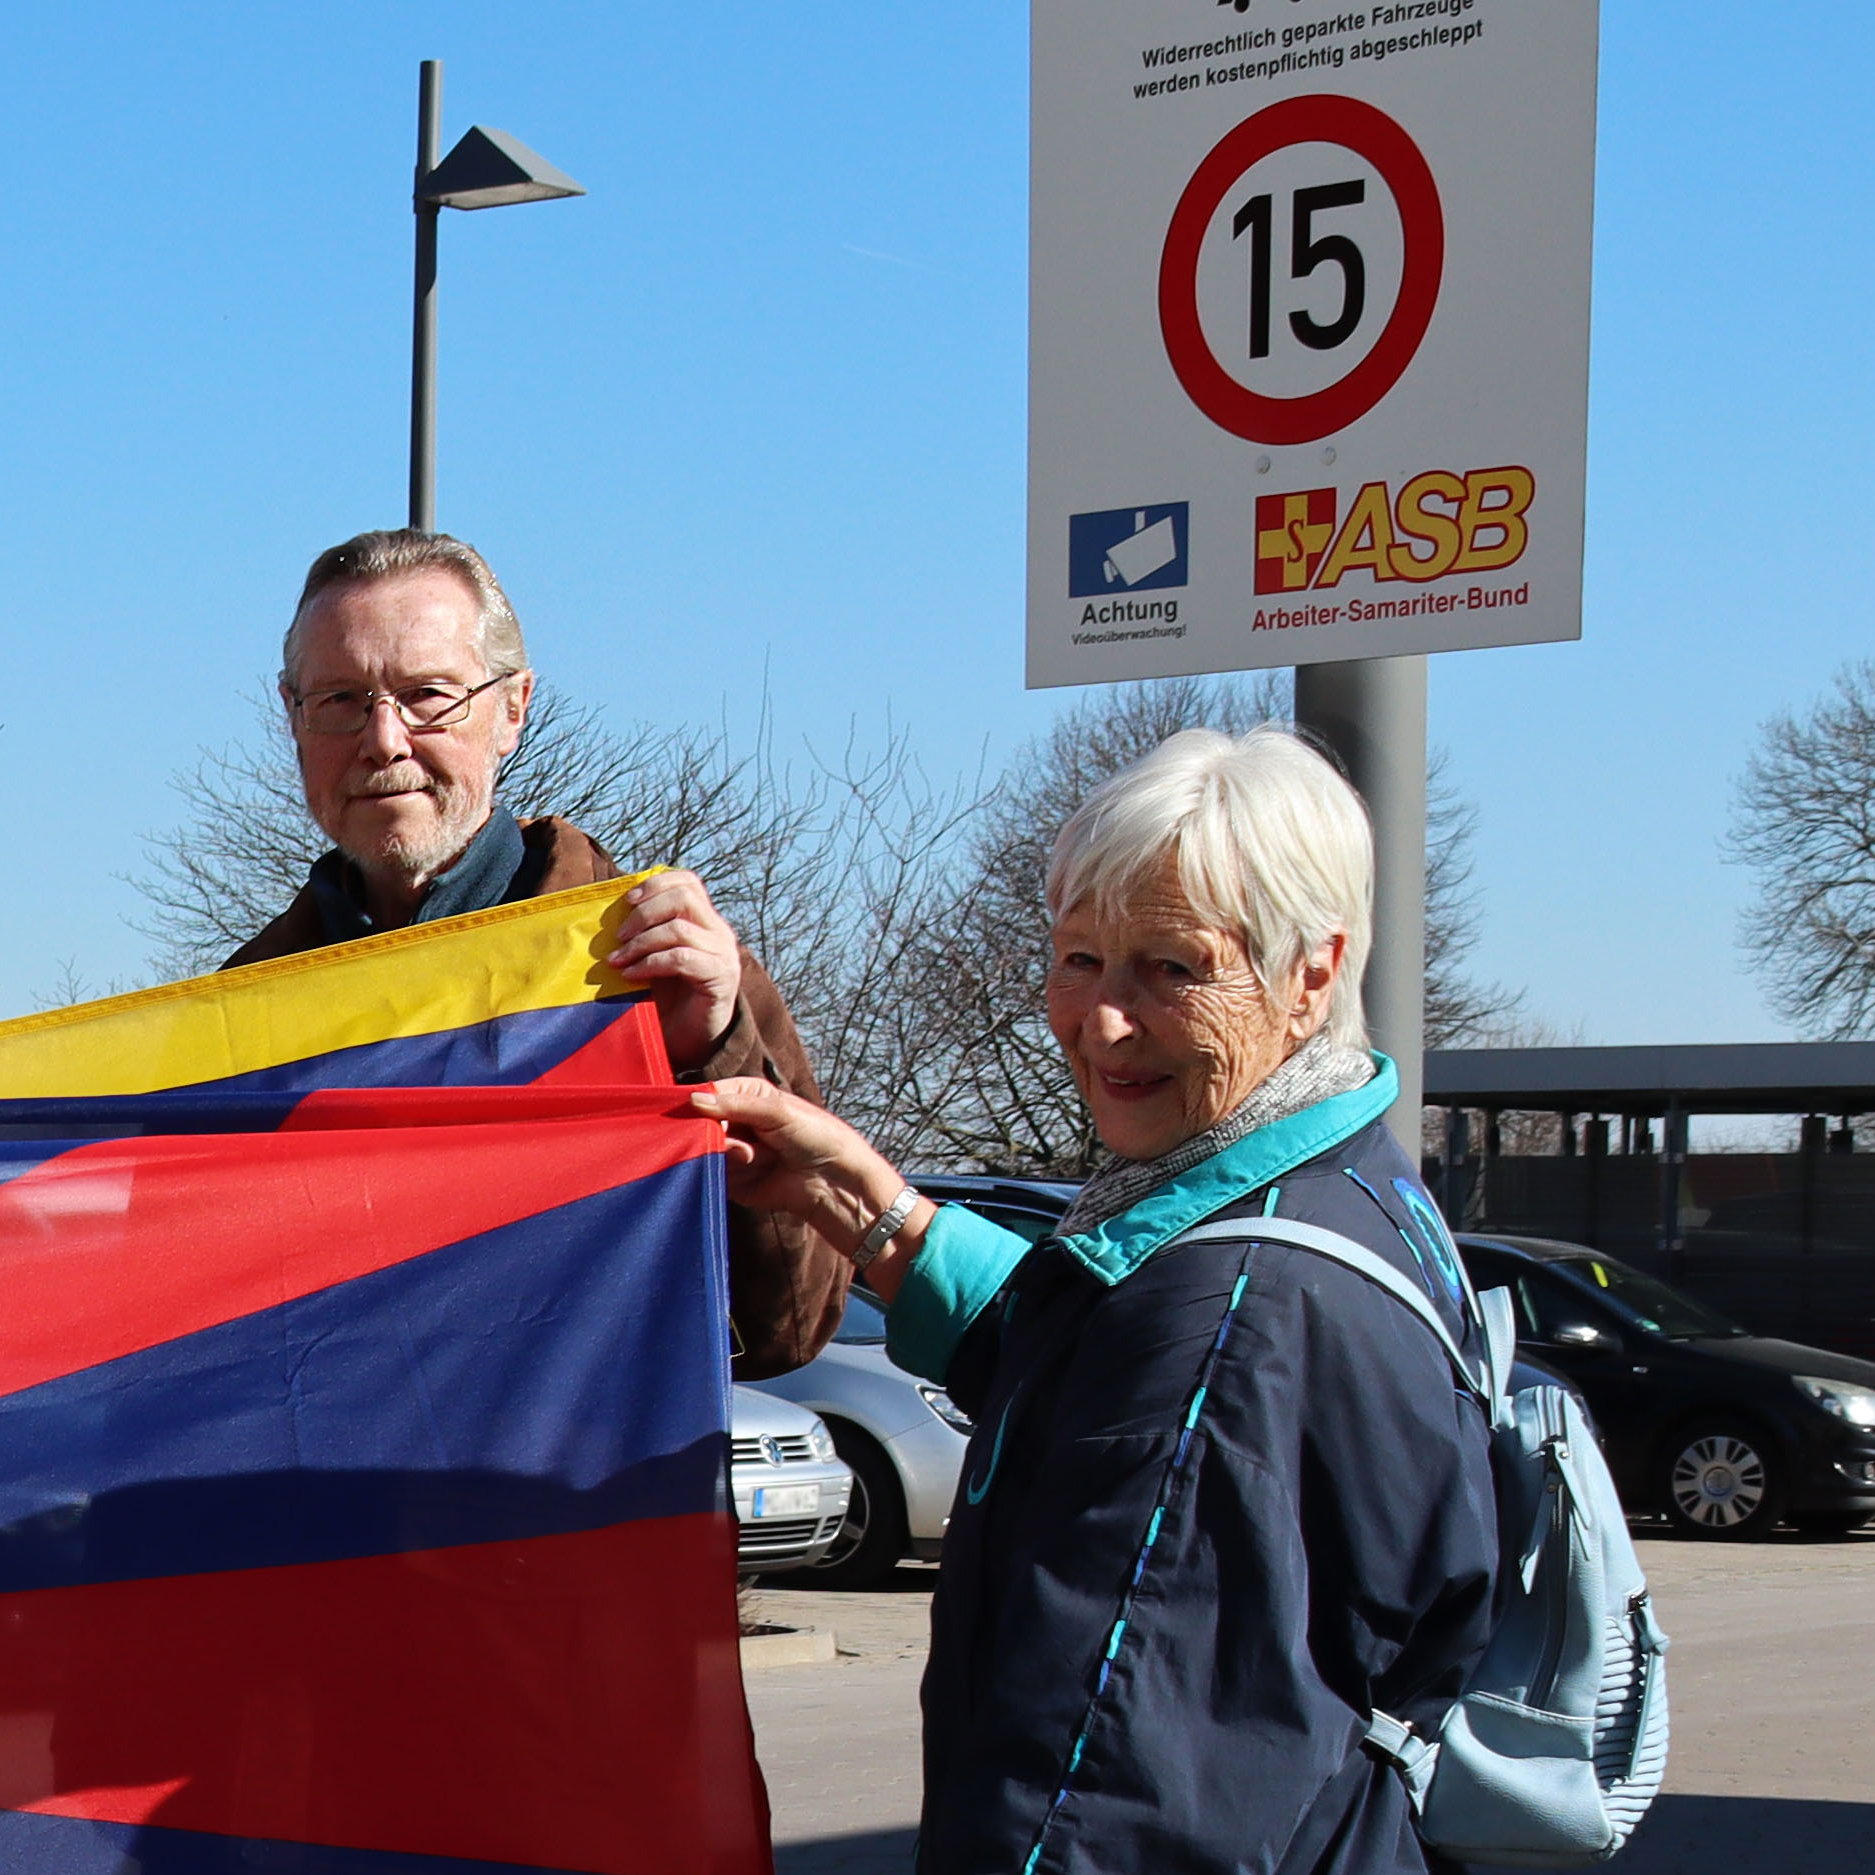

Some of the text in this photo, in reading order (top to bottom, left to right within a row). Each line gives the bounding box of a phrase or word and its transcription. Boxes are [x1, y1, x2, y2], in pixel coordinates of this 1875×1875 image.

[1133, 20, 1484, 99] werden kostenpflichtig abgeschleppt
[1142, 0, 1474, 69] Widerrechtlich geparkte Fahrzeuge
[1232, 178, 1366, 359] 15
[1312, 465, 1536, 590] ASB
[1071, 623, 1188, 646] Videoüberwachung!
[1080, 599, 1179, 626] Achtung
[1251, 582, 1530, 632] Arbeiter-Samariter-Bund
